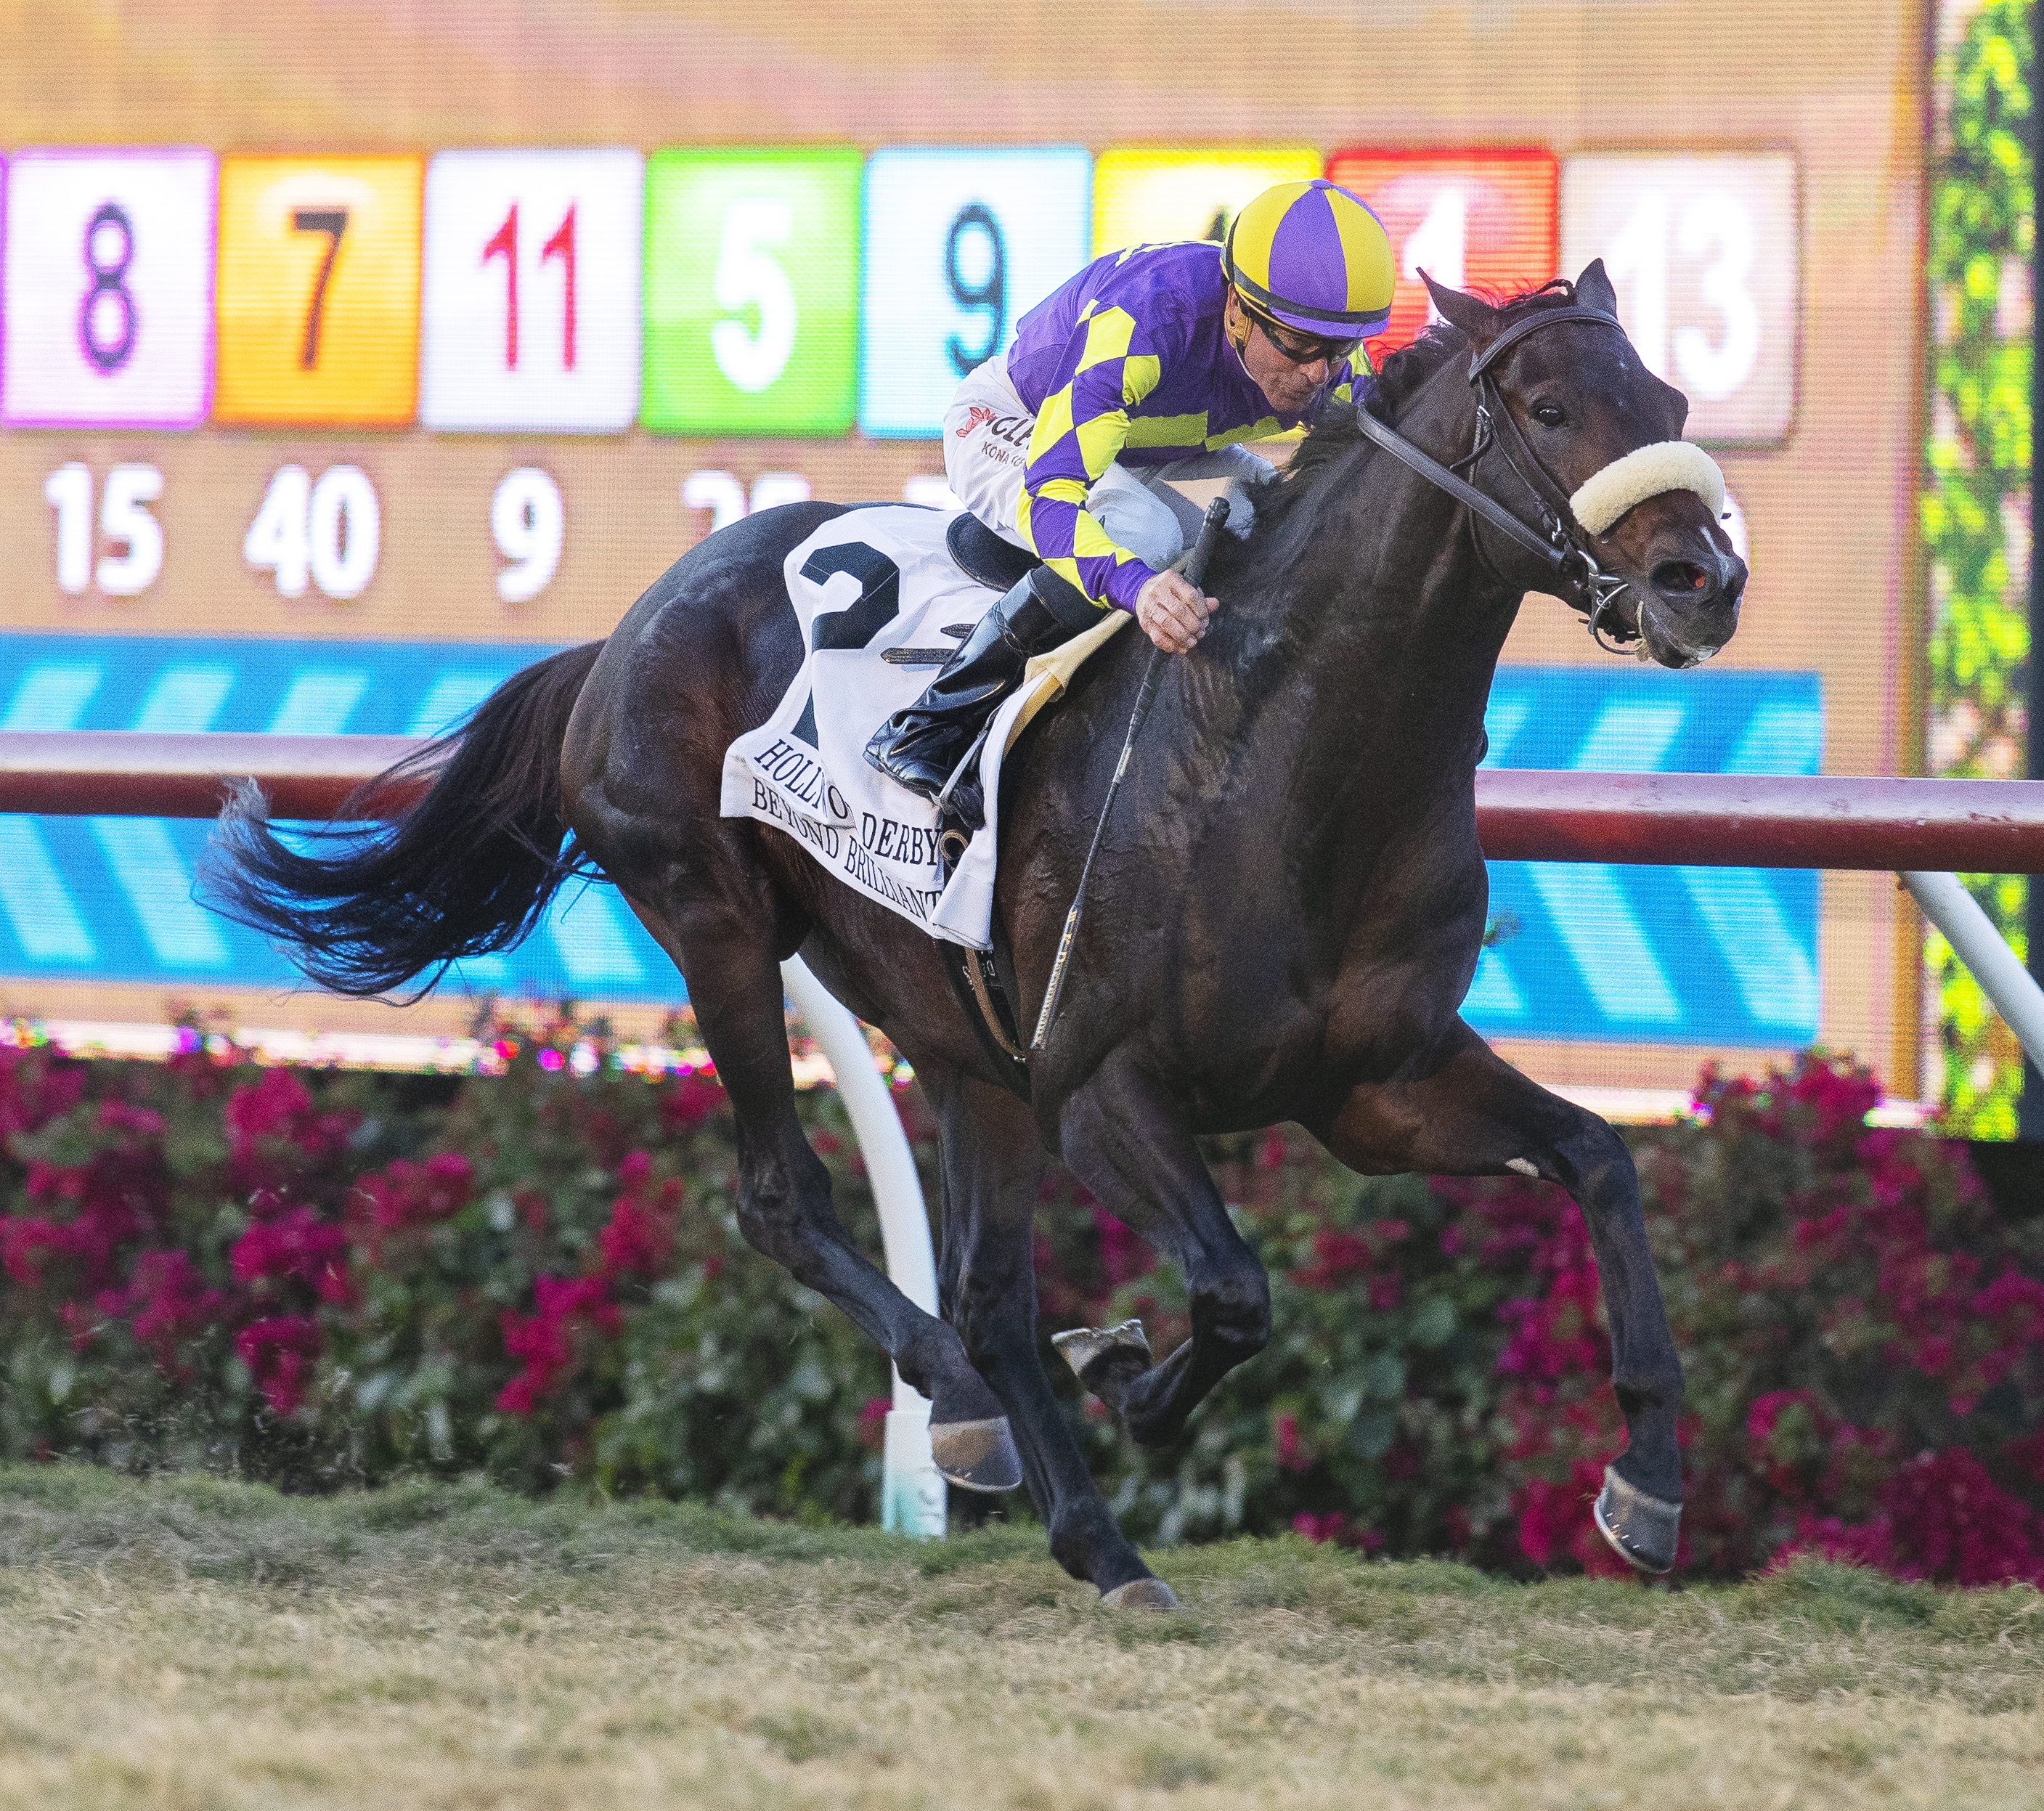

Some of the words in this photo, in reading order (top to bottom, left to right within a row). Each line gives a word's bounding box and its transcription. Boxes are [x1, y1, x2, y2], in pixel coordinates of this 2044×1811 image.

[81, 202, 137, 375] 8
[292, 208, 351, 372] 7
[480, 200, 580, 372] 11
[710, 202, 799, 394] 5
[945, 201, 1006, 377] 9
[1603, 187, 1759, 401] 13
[44, 461, 164, 595] 15
[982, 441, 1010, 465] KONA
[244, 464, 381, 600] 40
[491, 467, 565, 602] 9
[752, 776, 839, 860] BEYOND
[844, 835, 944, 923] BRILLIANT
[862, 812, 942, 866] DERBY
